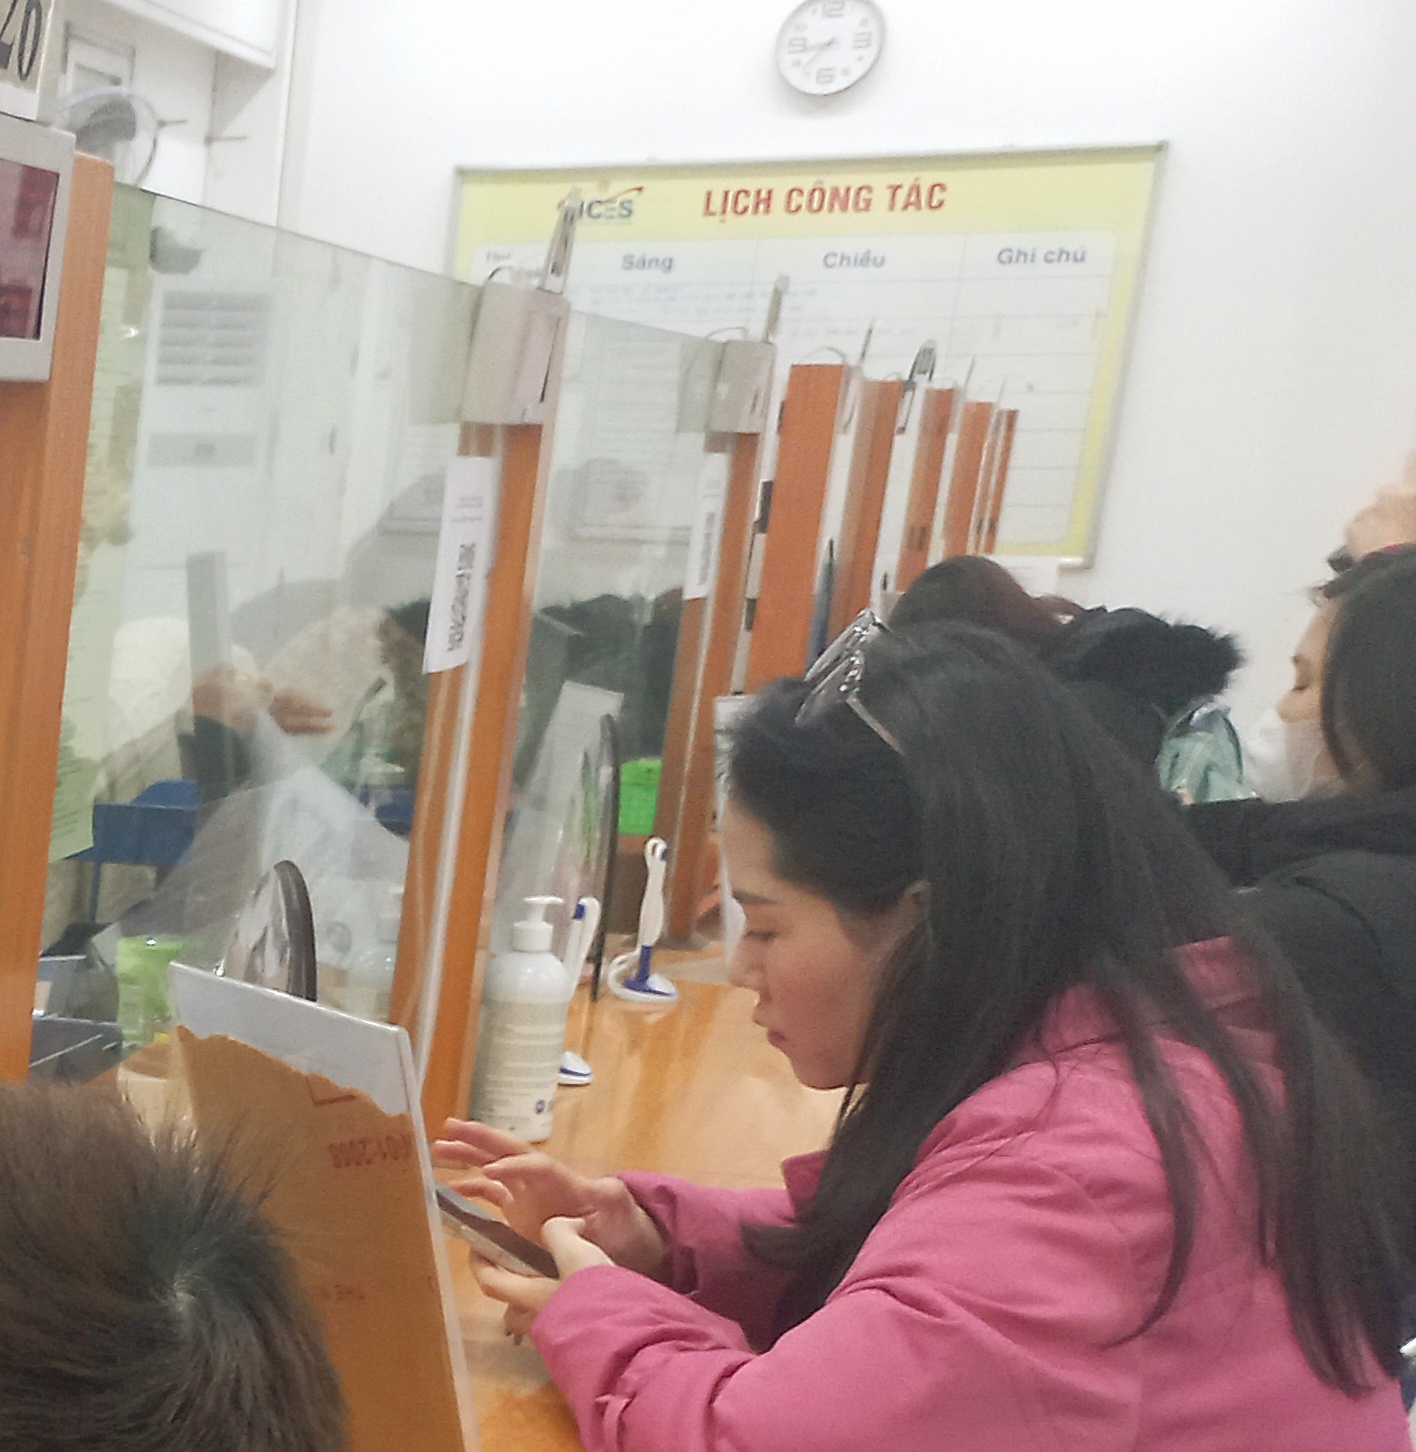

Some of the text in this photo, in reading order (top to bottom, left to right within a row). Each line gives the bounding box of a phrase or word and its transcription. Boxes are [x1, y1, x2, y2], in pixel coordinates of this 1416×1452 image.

[702, 177, 948, 223] LỊCH CÔNG TÁC
[621, 252, 674, 274] Sáng
[822, 249, 887, 269] Chiều
[997, 246, 1088, 266] Ghi chú
